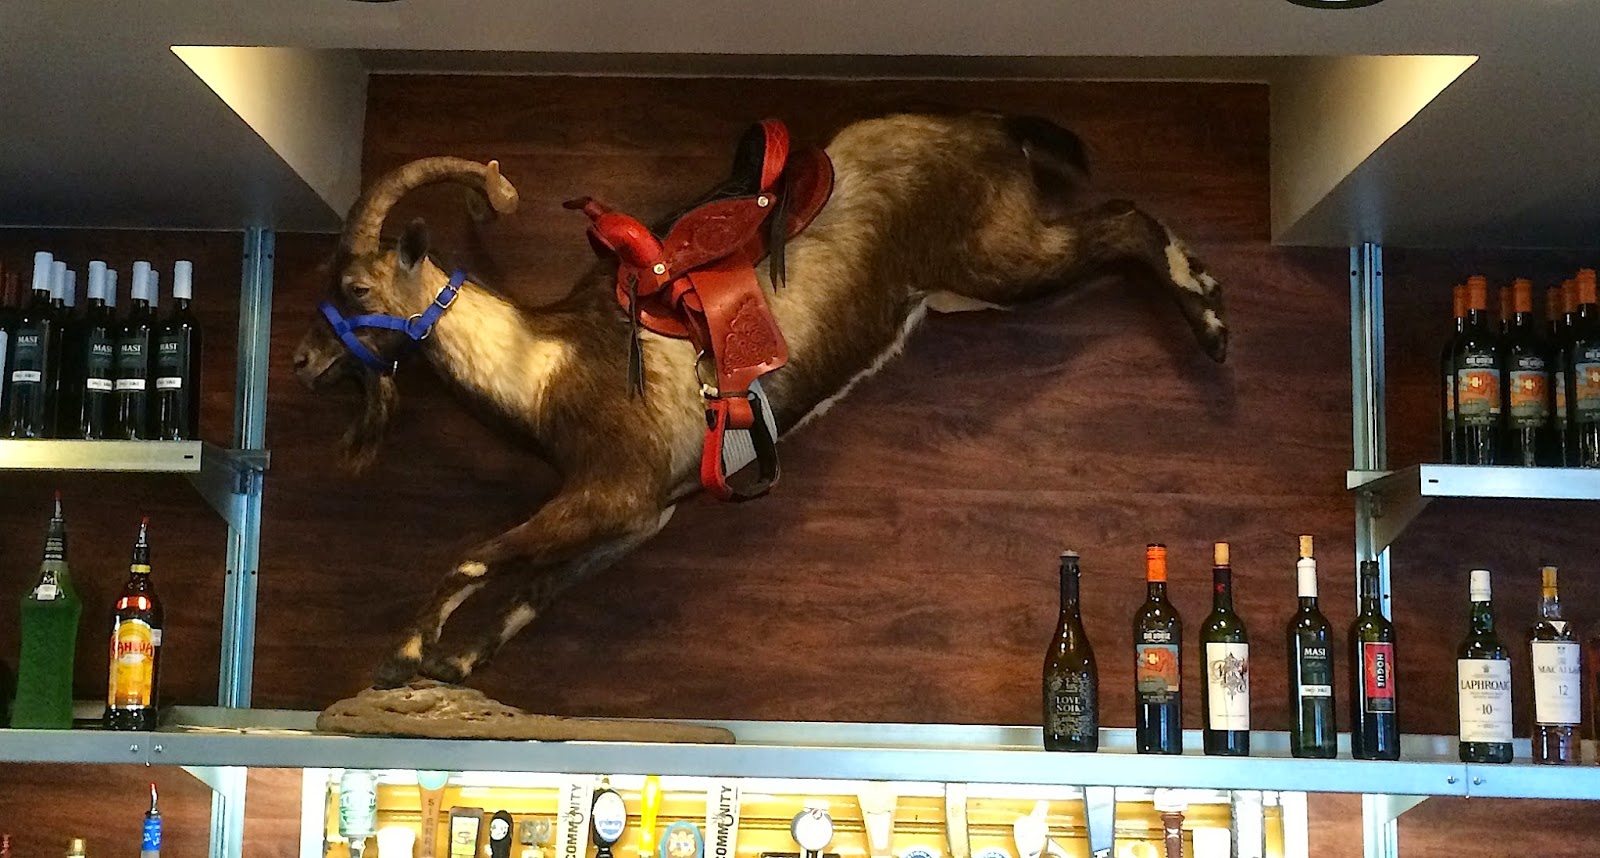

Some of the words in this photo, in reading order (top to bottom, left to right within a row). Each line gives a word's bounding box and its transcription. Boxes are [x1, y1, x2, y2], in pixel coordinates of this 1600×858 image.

[1304, 648, 1326, 656] MASI
[1376, 654, 1385, 687] HOGUE
[1558, 684, 1569, 696] 12
[1056, 696, 1081, 704] LOVE
[1482, 704, 1493, 715] 10
[716, 785, 735, 858] OMMUNITY
